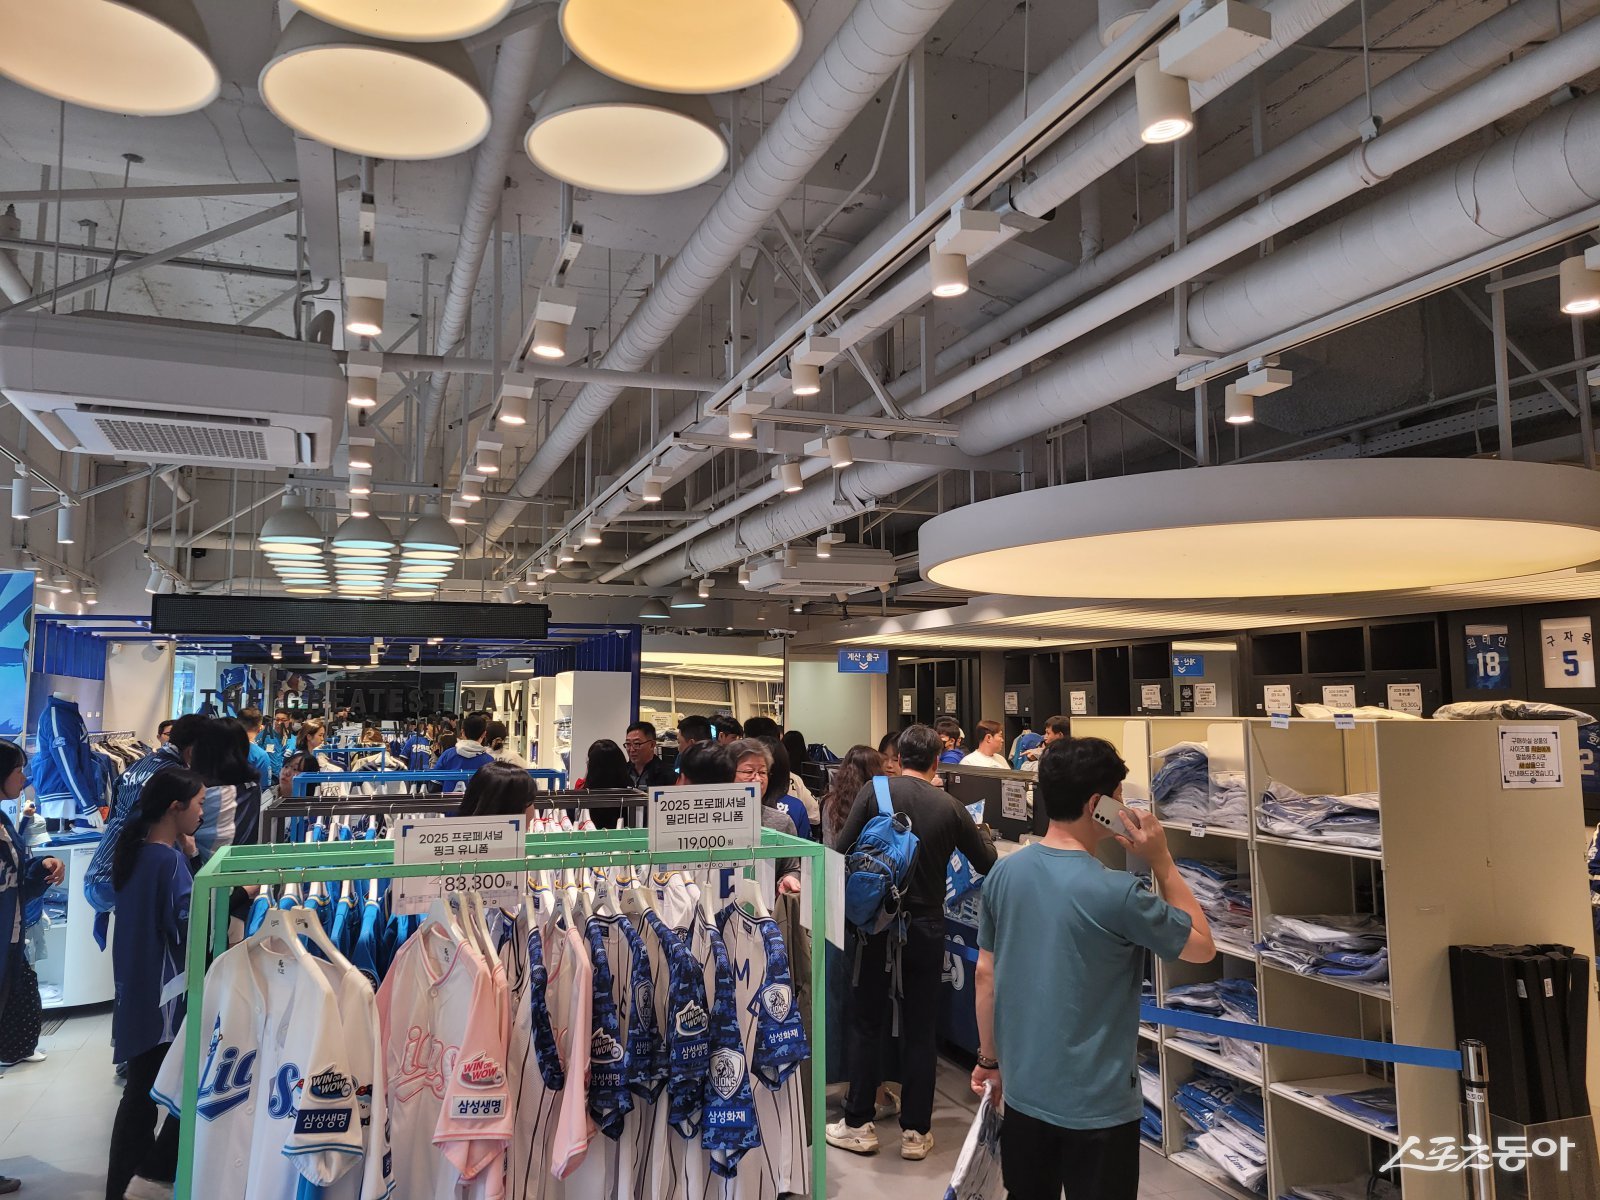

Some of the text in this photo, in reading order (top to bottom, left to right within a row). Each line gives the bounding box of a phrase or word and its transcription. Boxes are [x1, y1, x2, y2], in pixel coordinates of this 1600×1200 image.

[1546, 631, 1591, 647] 구자욱
[1477, 652, 1500, 676] 18
[1563, 650, 1579, 676] 5
[200, 688, 523, 713] THE GREATEST GAM
[660, 796, 746, 812] 2025 프로페셔널
[666, 810, 744, 826] 밀리터리 유니폼
[419, 830, 503, 845] 2025 프로페셔널
[433, 843, 489, 856] 핑크 유니폼
[680, 1010, 694, 1022] WIN
[768, 1004, 788, 1015] LIONS
[768, 1029, 799, 1044] 삼성화재
[681, 1043, 708, 1060] 삼성생명
[463, 1061, 483, 1073] WIN
[472, 1067, 498, 1082] WOW
[312, 1072, 333, 1087] WIN
[714, 1077, 737, 1088] LIONS
[321, 1081, 346, 1095] WOW
[458, 1099, 502, 1115] 삼성생명
[303, 1112, 348, 1130] 삼성생명
[708, 1110, 746, 1125] 삼성화재
[1224, 1152, 1247, 1172] Lions
